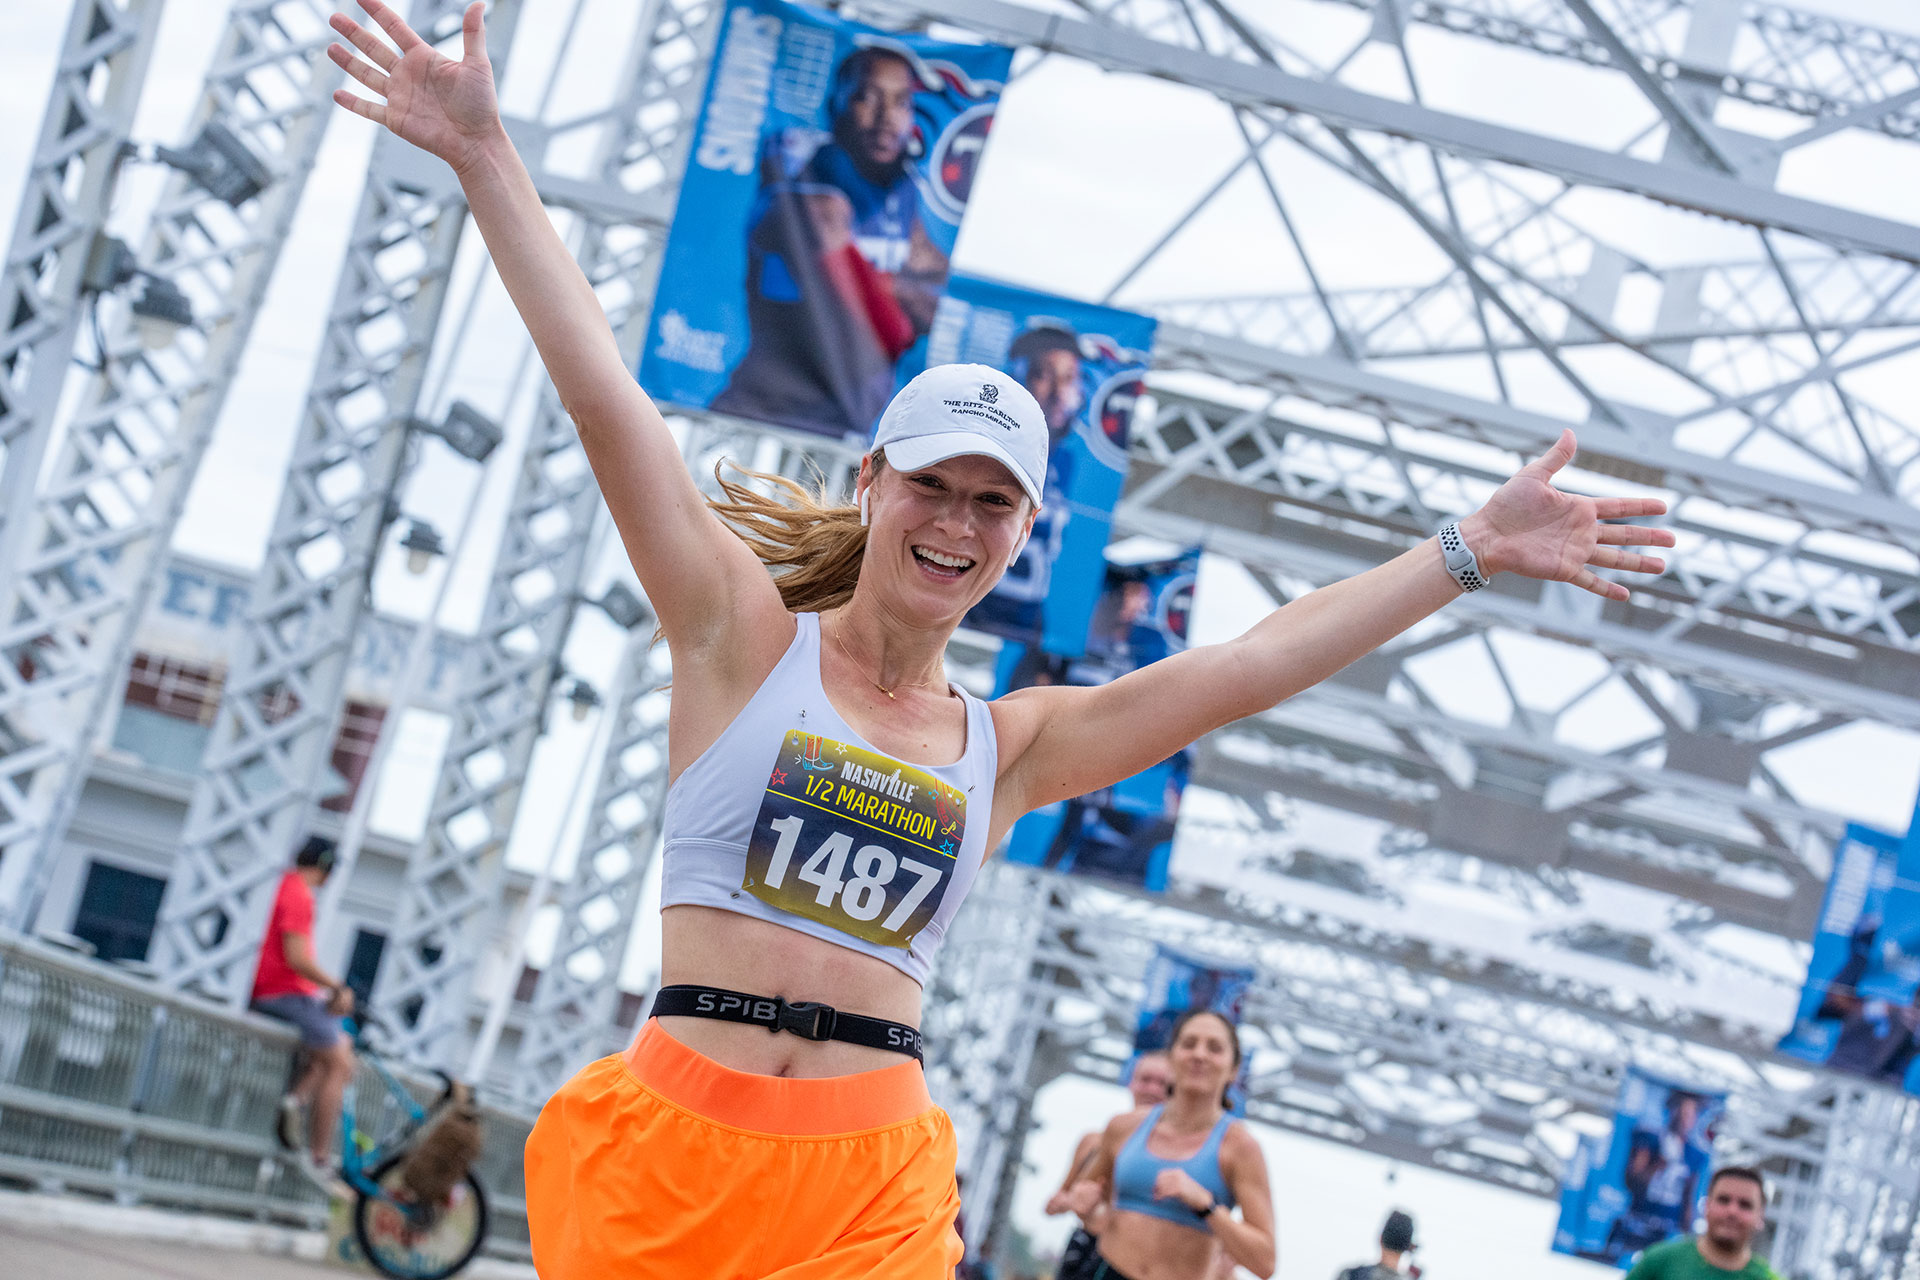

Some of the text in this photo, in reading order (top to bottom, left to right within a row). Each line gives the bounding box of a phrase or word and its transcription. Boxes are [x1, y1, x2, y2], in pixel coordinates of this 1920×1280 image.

[943, 399, 1021, 429] THE RITZ-CARLTON
[951, 408, 1012, 431] RANCHO MIRAGE
[840, 760, 917, 803] NASHVILLE
[805, 775, 834, 802] 1/2
[835, 785, 938, 840] MARATHON
[763, 814, 944, 933] 1487
